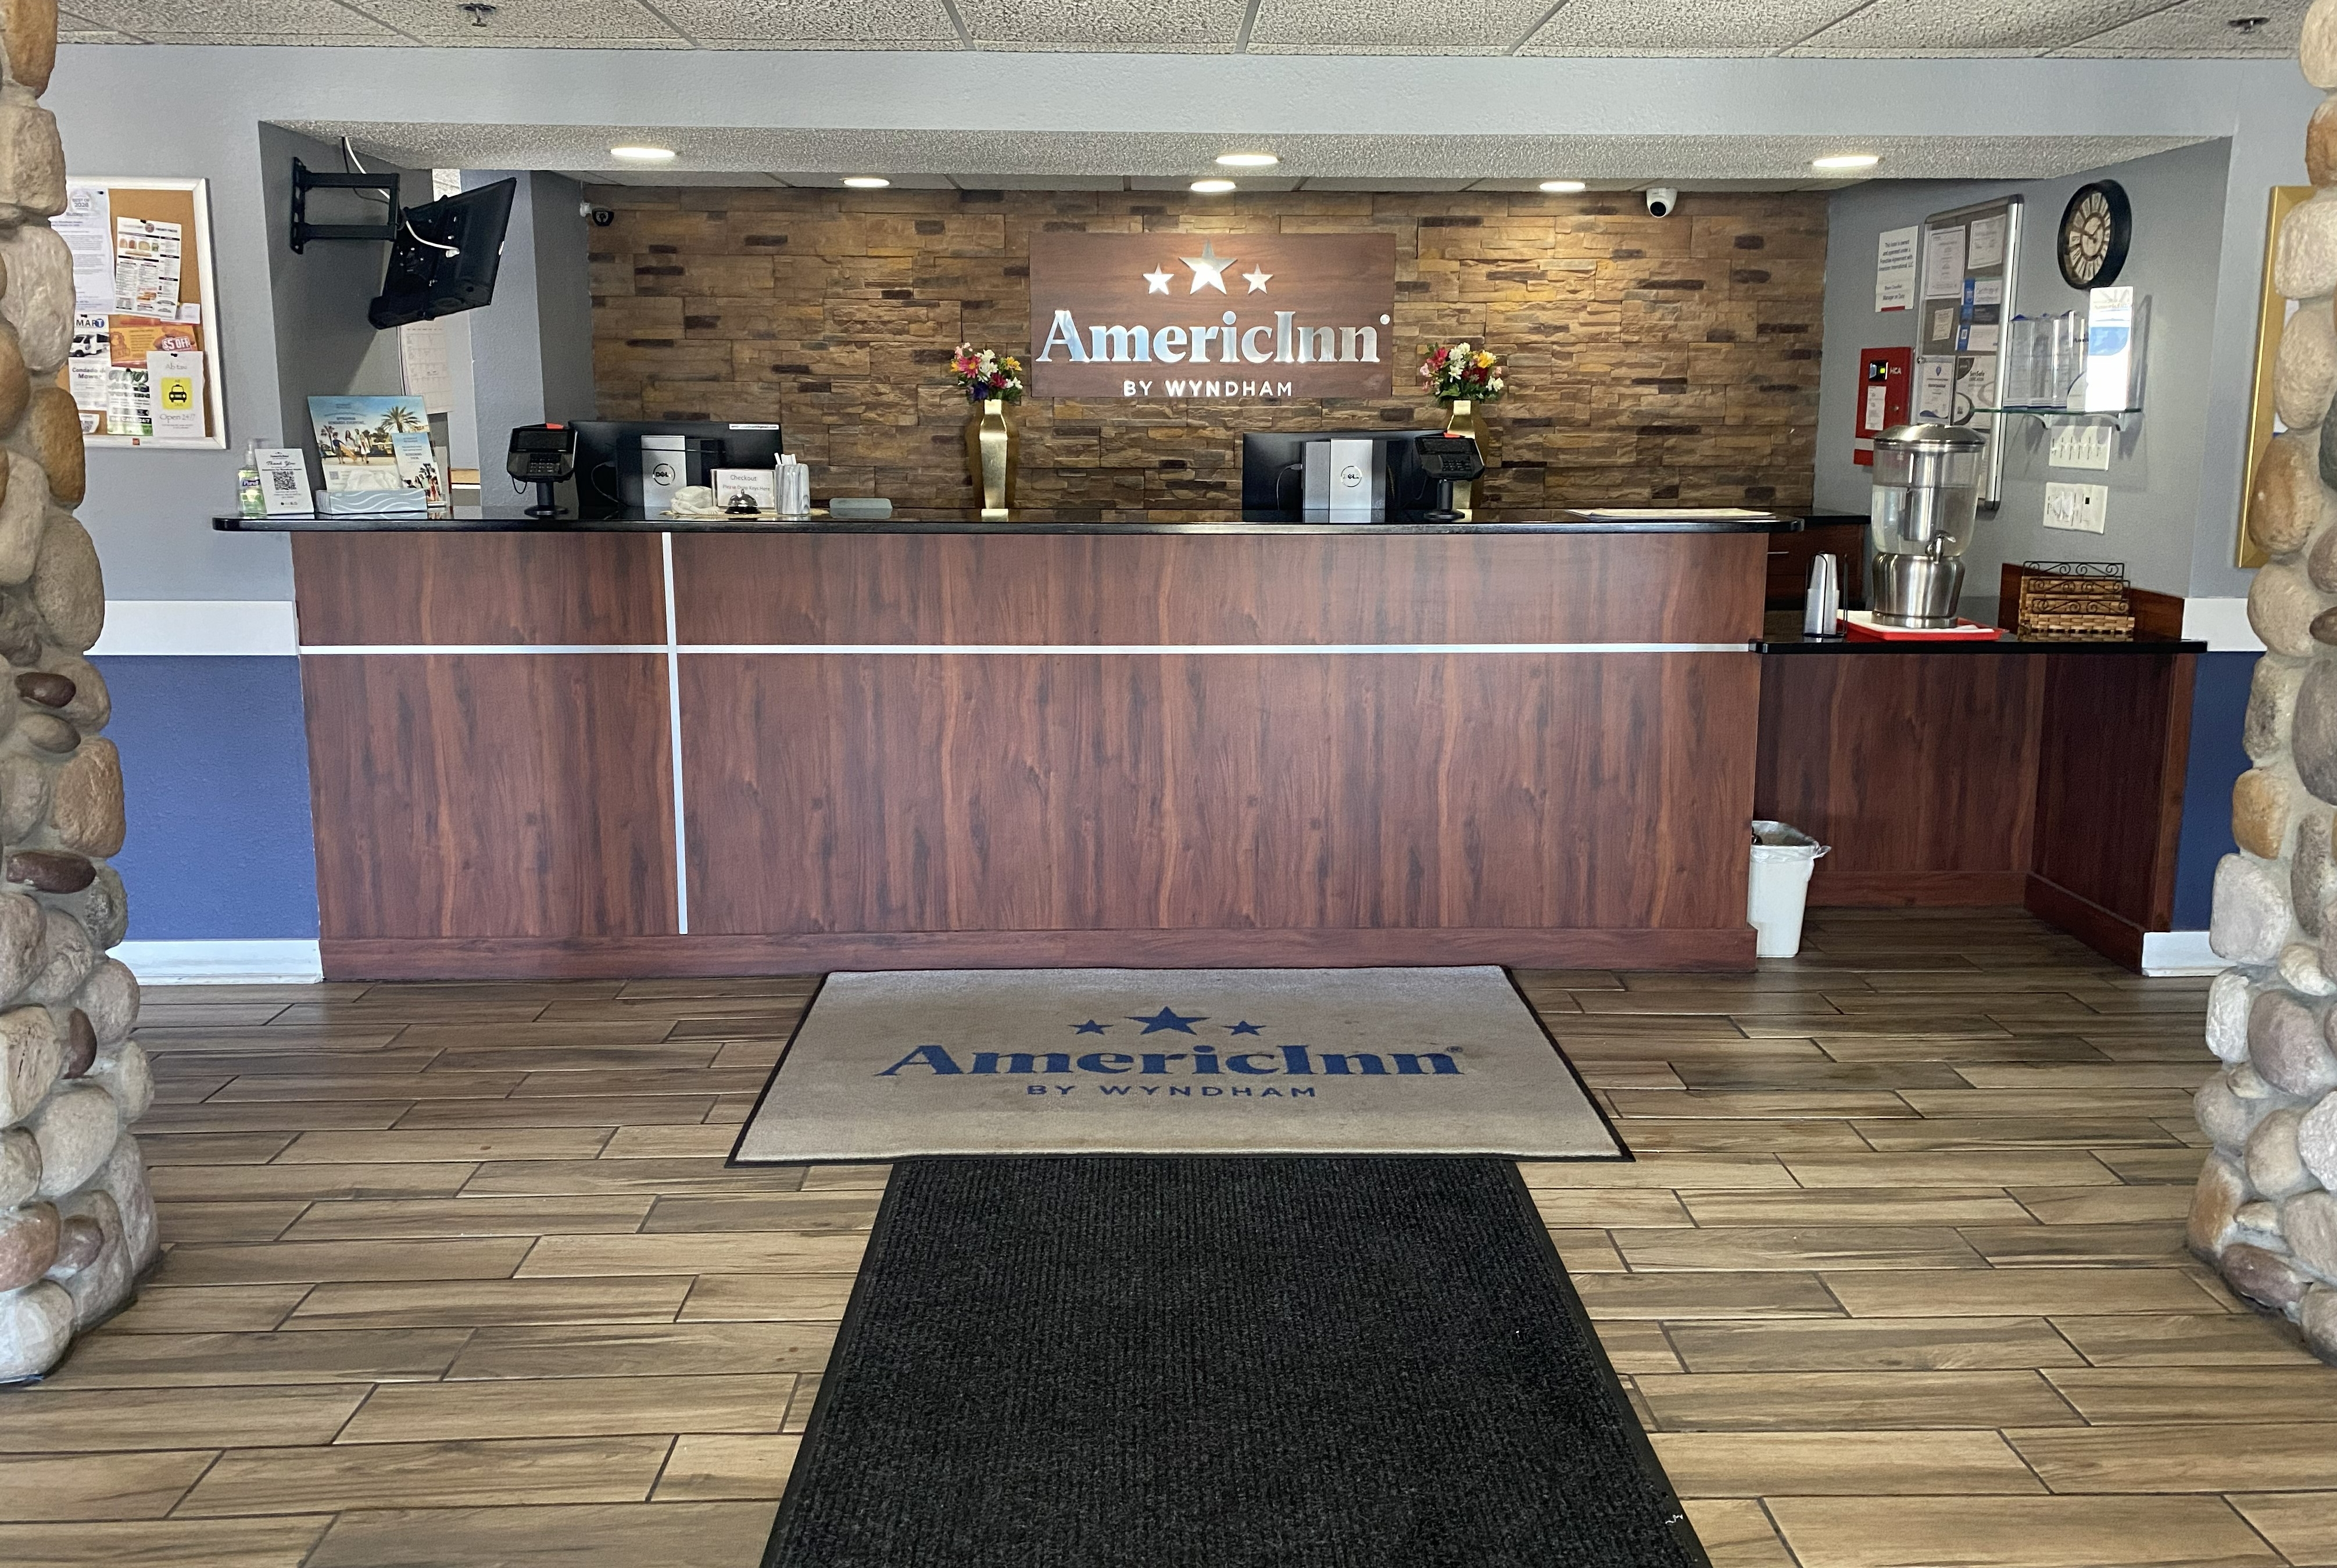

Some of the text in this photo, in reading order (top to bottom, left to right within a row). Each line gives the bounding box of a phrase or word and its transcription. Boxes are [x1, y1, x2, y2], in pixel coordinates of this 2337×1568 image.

[163, 337, 189, 349] $5 OFF
[1123, 380, 1292, 397] BY WYNDHAM
[159, 413, 181, 423] Open
[1027, 1085, 1316, 1097] BY WYNDHAM
